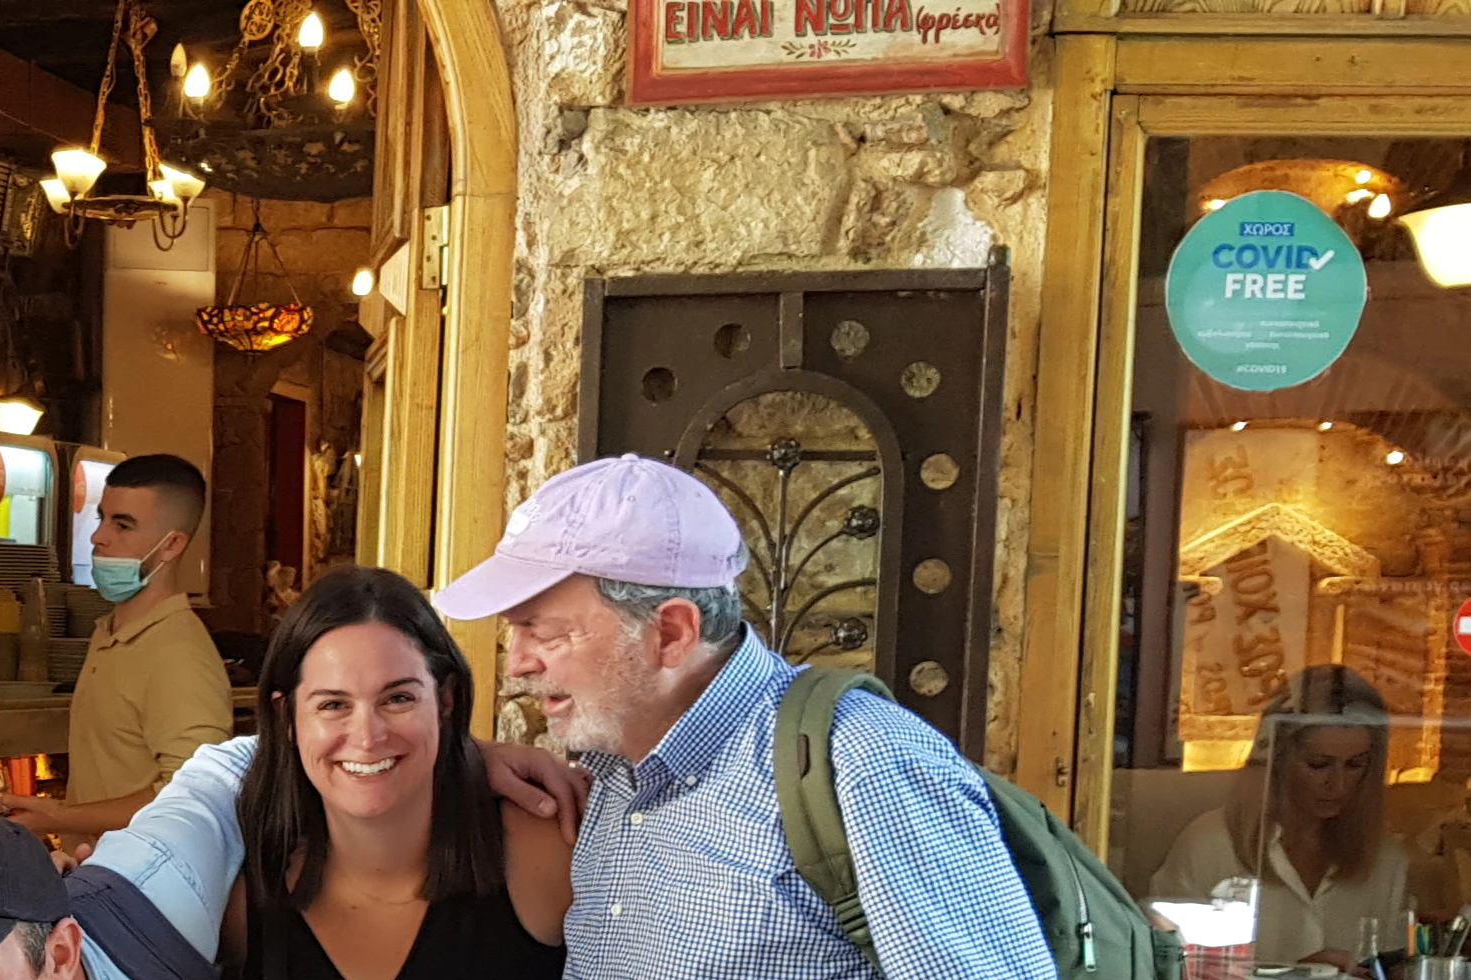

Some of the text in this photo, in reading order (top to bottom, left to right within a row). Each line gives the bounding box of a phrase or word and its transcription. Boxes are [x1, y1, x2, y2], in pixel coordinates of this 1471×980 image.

[665, 0, 774, 44] ΕΙΝΑΙ
[1243, 223, 1292, 236] ΧΩΡΟΣ
[1211, 243, 1320, 269] COVID
[1224, 273, 1307, 300] FREE
